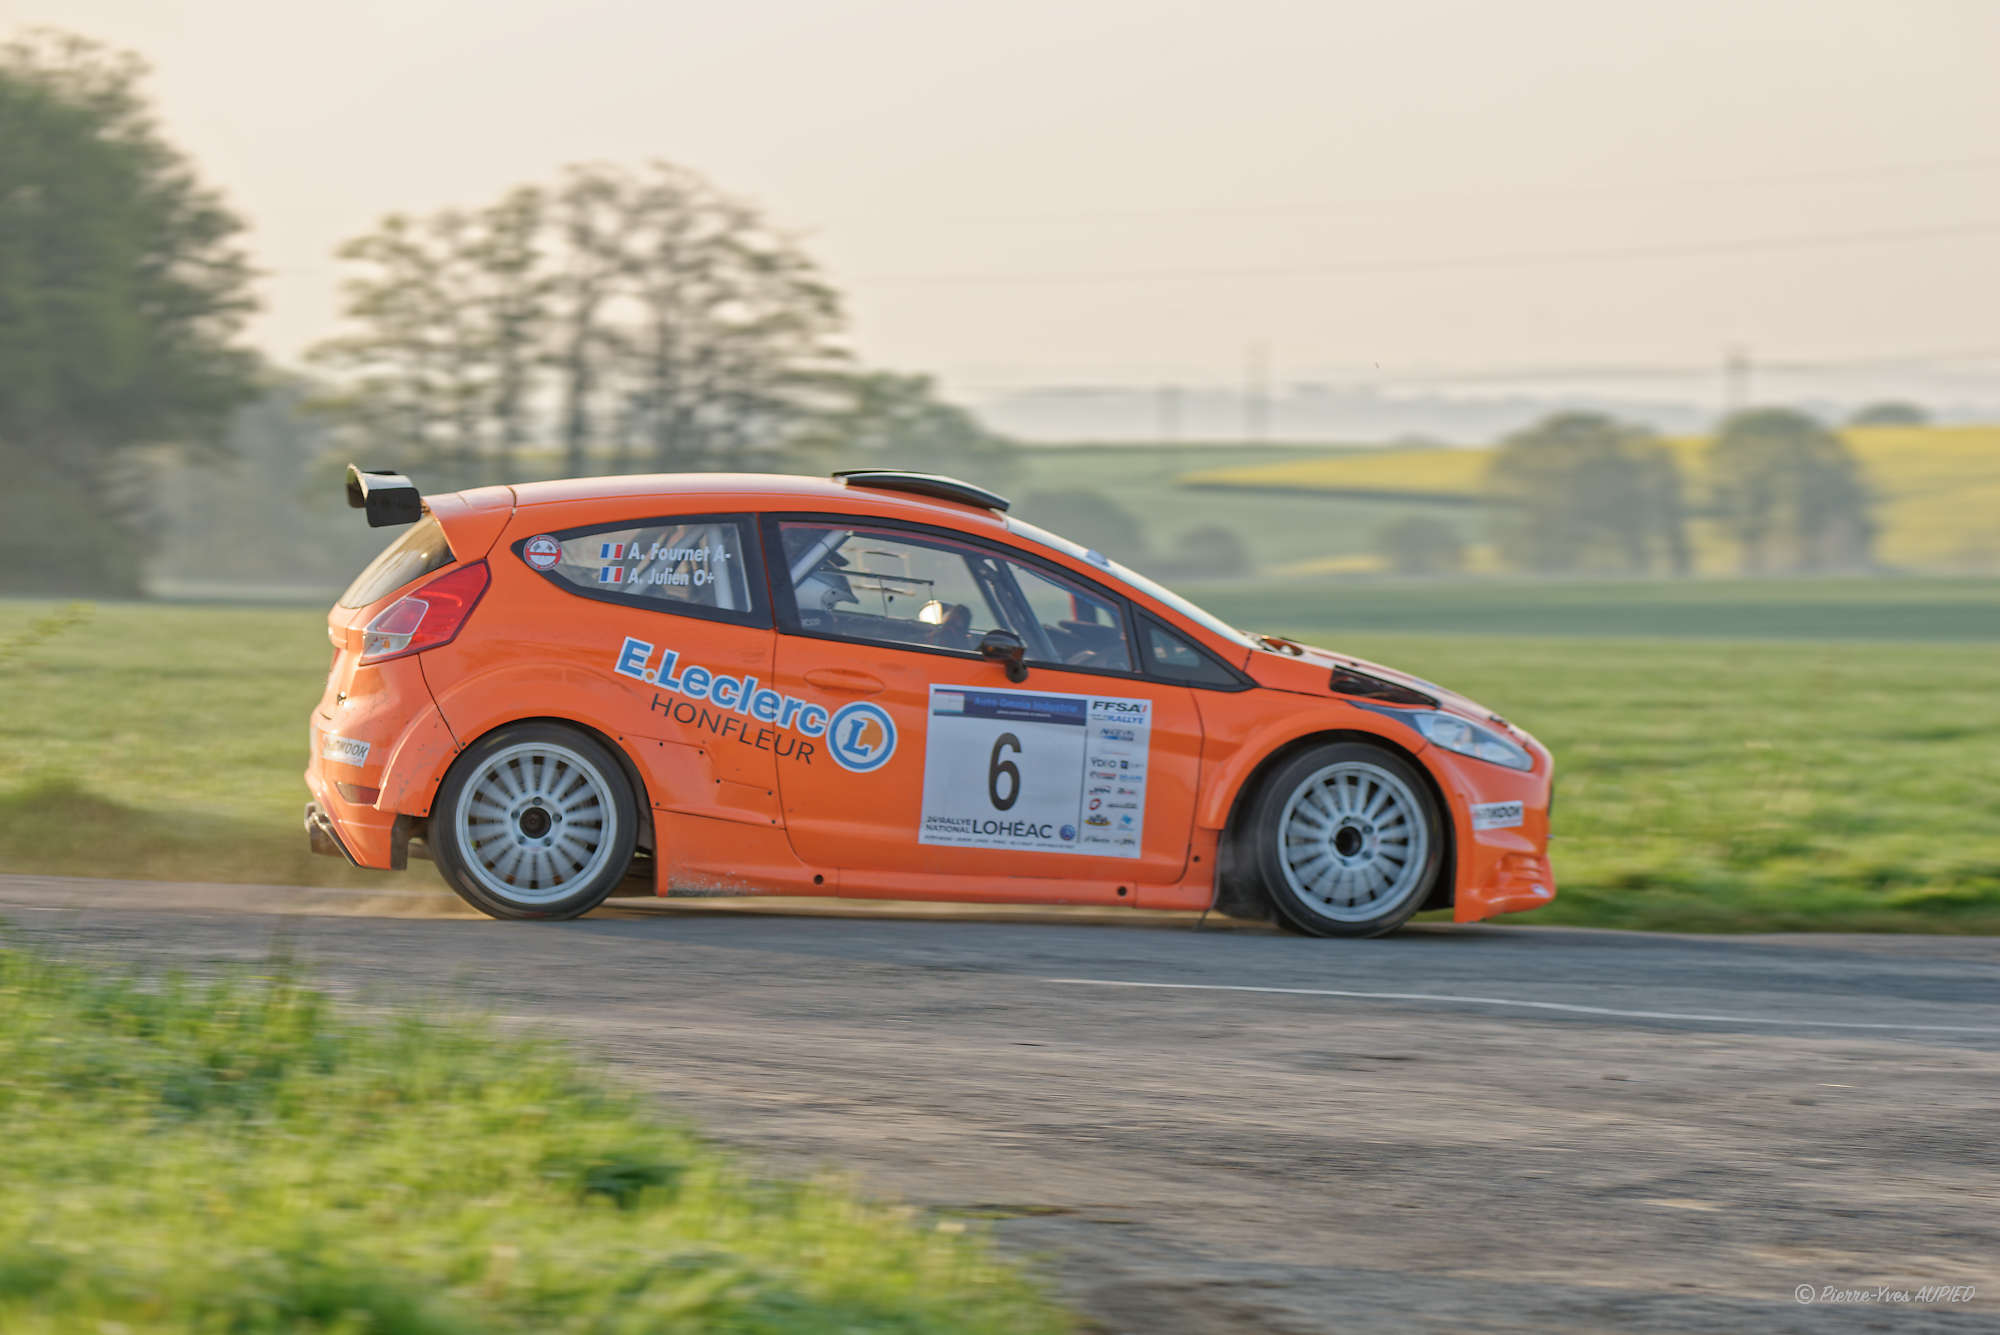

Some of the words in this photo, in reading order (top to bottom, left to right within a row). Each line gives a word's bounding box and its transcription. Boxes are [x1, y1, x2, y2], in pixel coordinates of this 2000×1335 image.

[628, 542, 646, 560] A.
[650, 543, 711, 562] Fournet
[648, 567, 689, 585] Julien
[614, 636, 829, 738] E.Leclerc
[1092, 701, 1141, 713] FFSA
[651, 693, 815, 764] HONFLEUR
[988, 732, 1023, 811] 6
[926, 824, 971, 834] NATIONAL
[973, 819, 1053, 839] LOHÉAC
